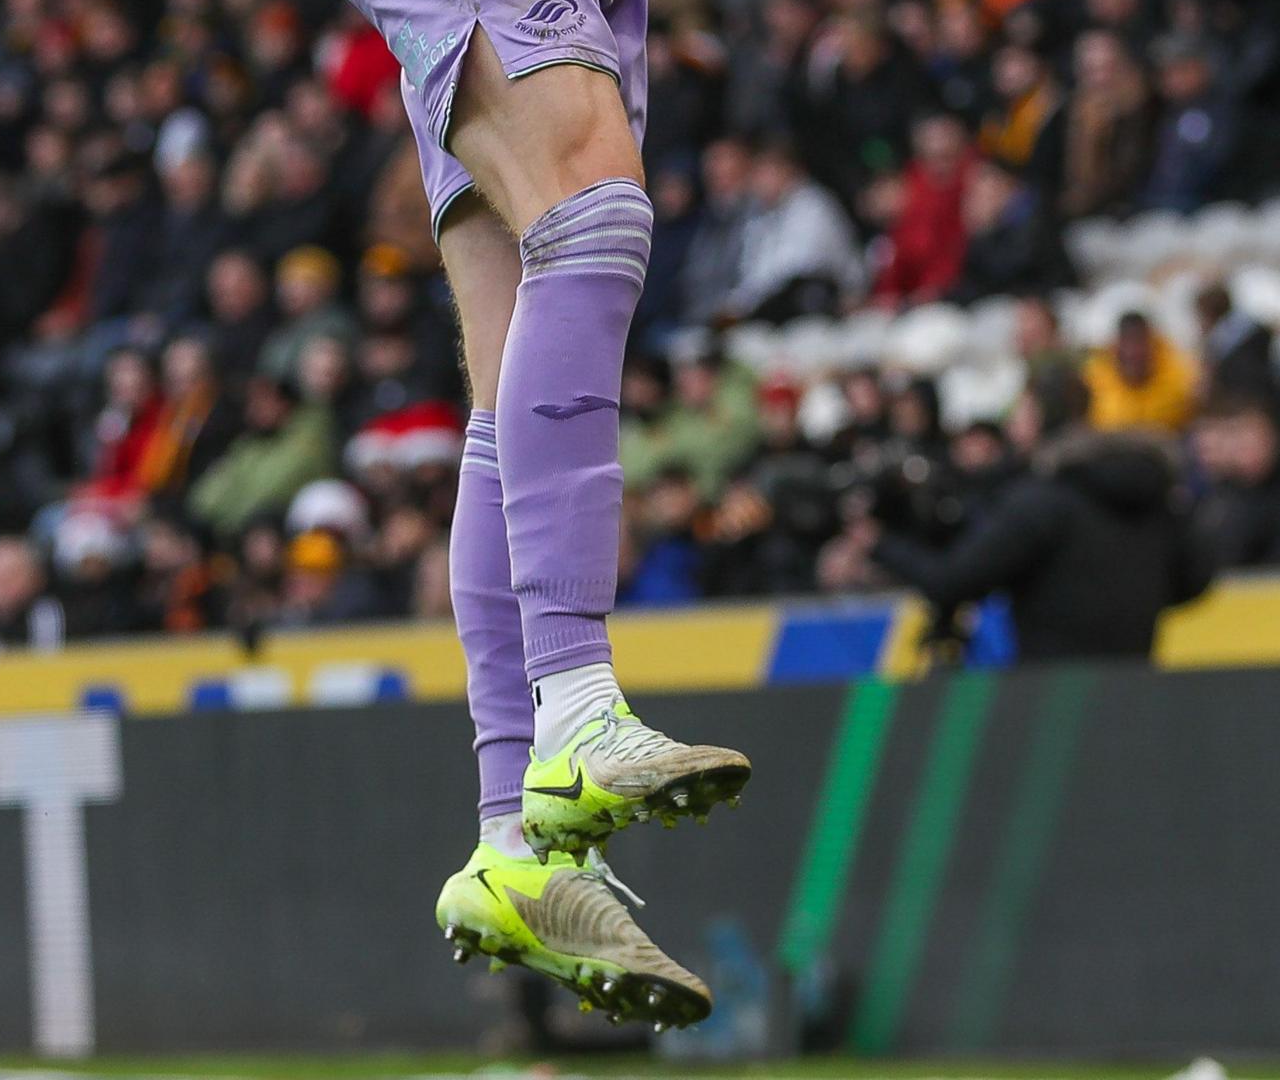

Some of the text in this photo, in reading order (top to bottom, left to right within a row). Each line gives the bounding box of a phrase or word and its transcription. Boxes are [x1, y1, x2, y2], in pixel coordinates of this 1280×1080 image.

[515, 21, 559, 38] SWANSEA
[560, 23, 578, 36] CITY
[423, 32, 458, 75] ECTS
